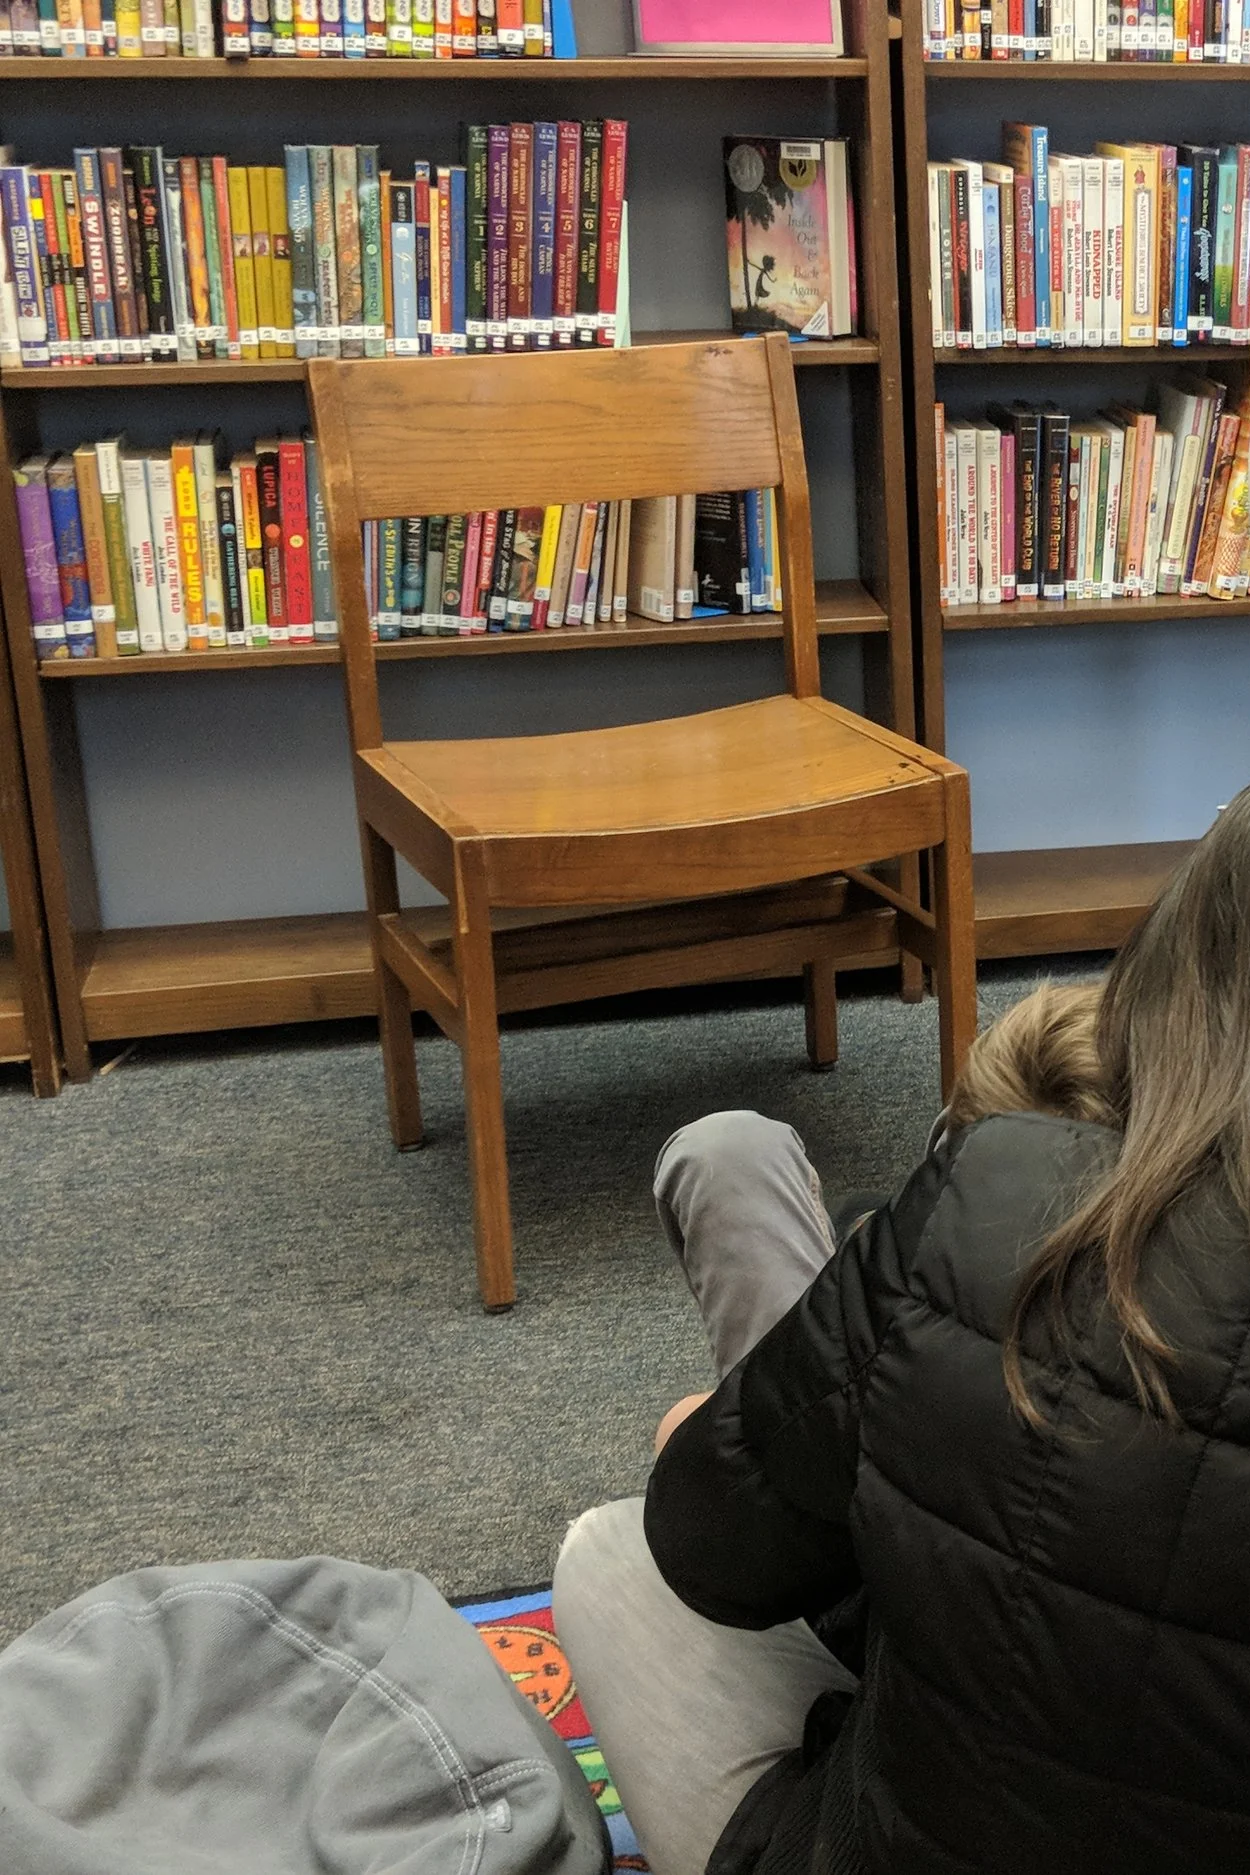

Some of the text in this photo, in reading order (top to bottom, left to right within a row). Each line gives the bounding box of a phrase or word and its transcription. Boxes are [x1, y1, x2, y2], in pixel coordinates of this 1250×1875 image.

[1037, 136, 1047, 201] Treasure Island
[478, 225, 484, 234] 1
[495, 224, 504, 235] 2
[515, 222, 524, 231] 3
[542, 222, 550, 232] 4
[564, 221, 571, 230] 5
[585, 219, 593, 229] 6
[610, 218, 617, 228] 7
[788, 214, 815, 228] Inside
[111, 206, 127, 286] ZOOBREAK
[797, 233, 817, 246] Out
[1002, 225, 1012, 285] Dangerous
[1092, 230, 1101, 299] KIDNAPPED
[1193, 228, 1212, 283] Goosebumps
[794, 266, 819, 278] Back
[790, 283, 819, 298] Again
[263, 465, 276, 508] LUPICA
[1023, 474, 1033, 491] END
[1050, 478, 1062, 505] RIVER
[163, 517, 172, 534] THE
[1023, 516, 1033, 546] WORLD
[1051, 517, 1063, 530] NO
[165, 536, 174, 556] CALL
[503, 527, 514, 548] STAG
[446, 516, 464, 583] OLL PEOPLE
[1023, 548, 1033, 570] CLUB
[1049, 534, 1062, 570] RETURN
[142, 541, 154, 587] WHITE FANG
[183, 522, 202, 601] RULES
[225, 541, 236, 586] GATHERING
[407, 539, 420, 585] REIGN
[481, 557, 492, 585] Hood
[169, 573, 178, 590] THE
[170, 593, 180, 614] WILD
